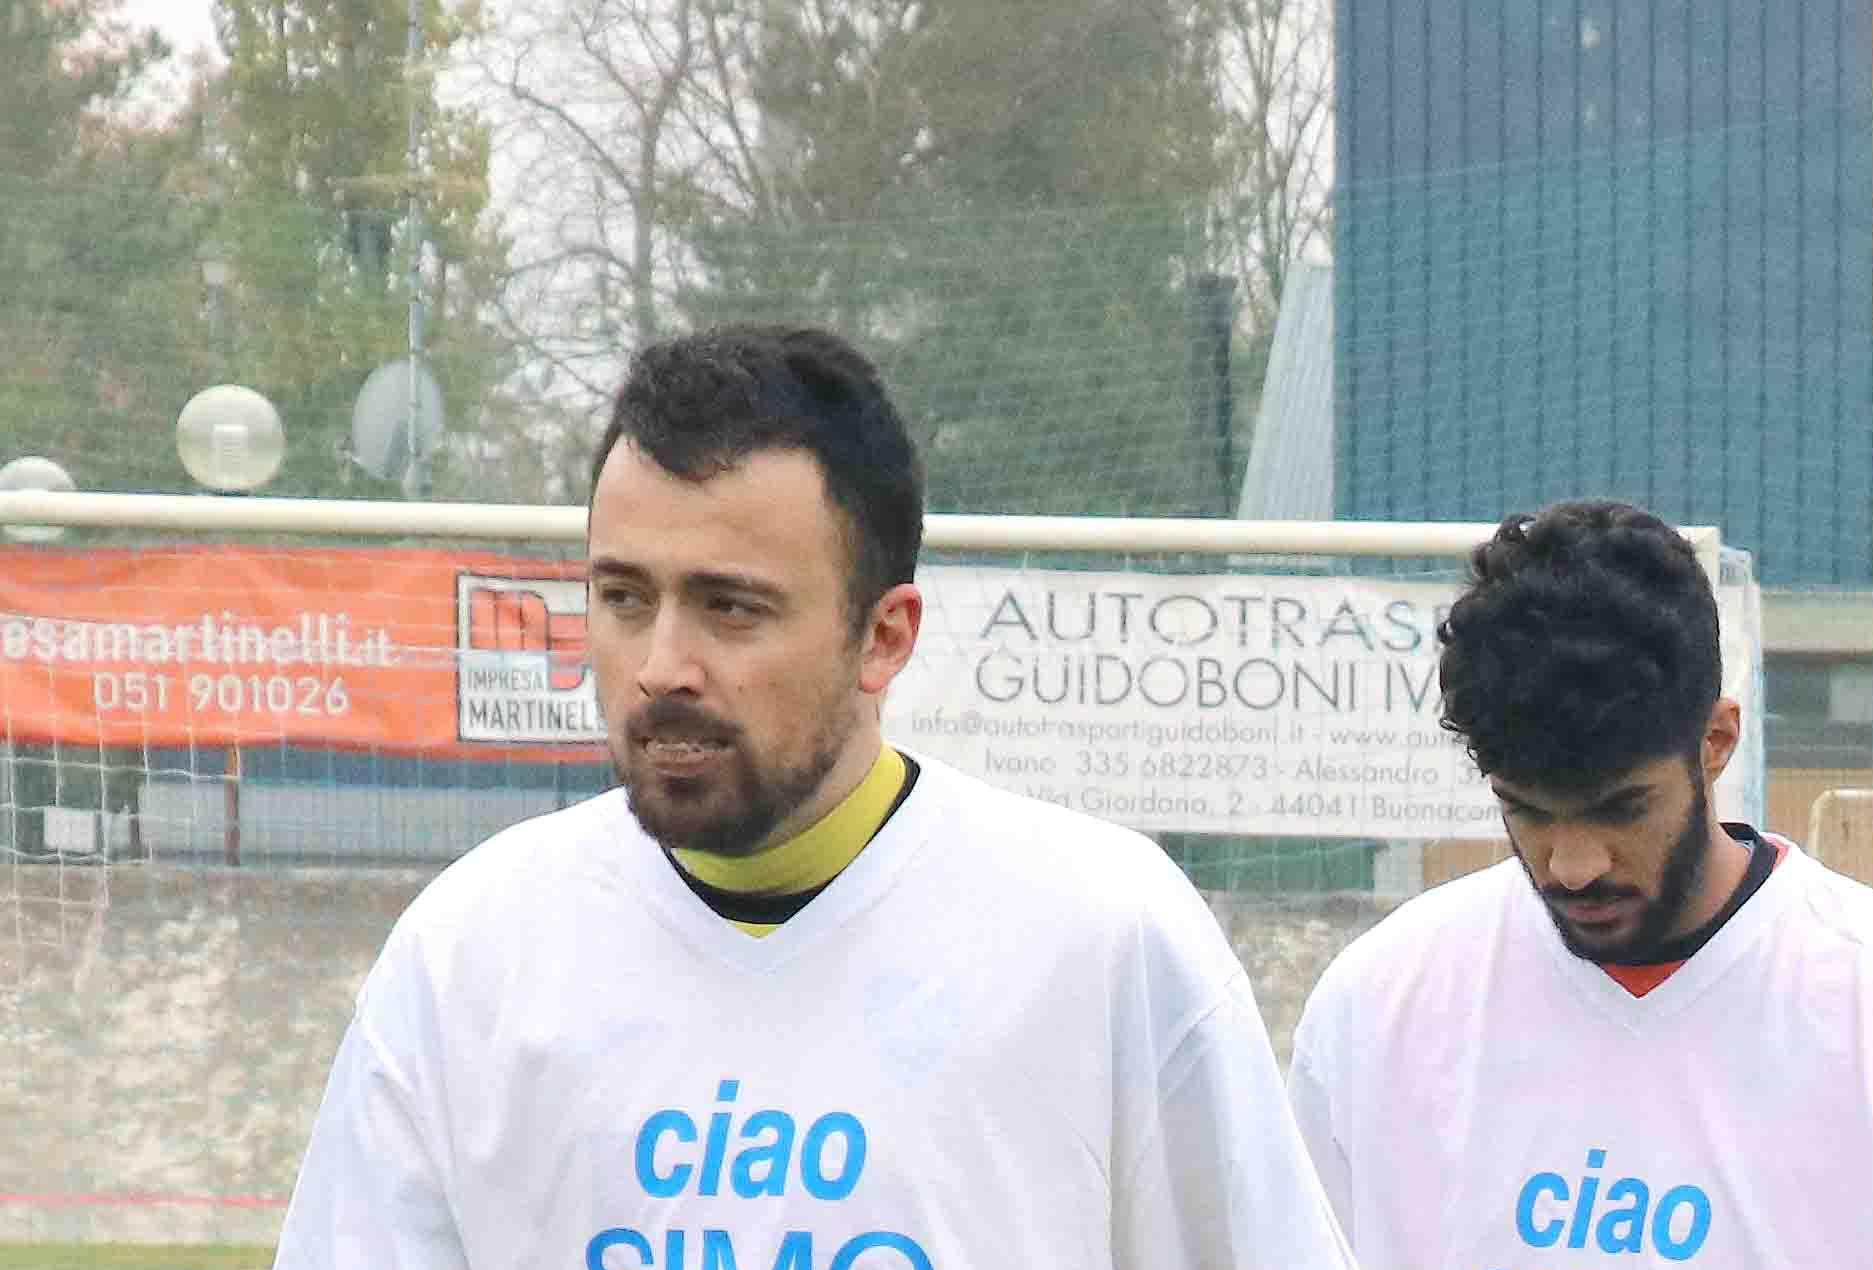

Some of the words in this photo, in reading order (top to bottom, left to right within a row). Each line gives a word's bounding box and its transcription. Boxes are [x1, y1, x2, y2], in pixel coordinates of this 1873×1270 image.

[95, 673, 170, 712] 051
[191, 674, 349, 714] 901026
[467, 670, 545, 689] IMPRESA
[975, 652, 1357, 712] GUIDOBONI
[1384, 660, 1440, 714] IV
[984, 746, 1057, 775] Ivano
[1076, 750, 1129, 777] 335
[1142, 752, 1267, 781] 6822873
[1296, 754, 1439, 785] Alessandro
[1229, 791, 1244, 816] 2
[635, 1079, 867, 1200] ciao
[1515, 1148, 1713, 1262] ciao
